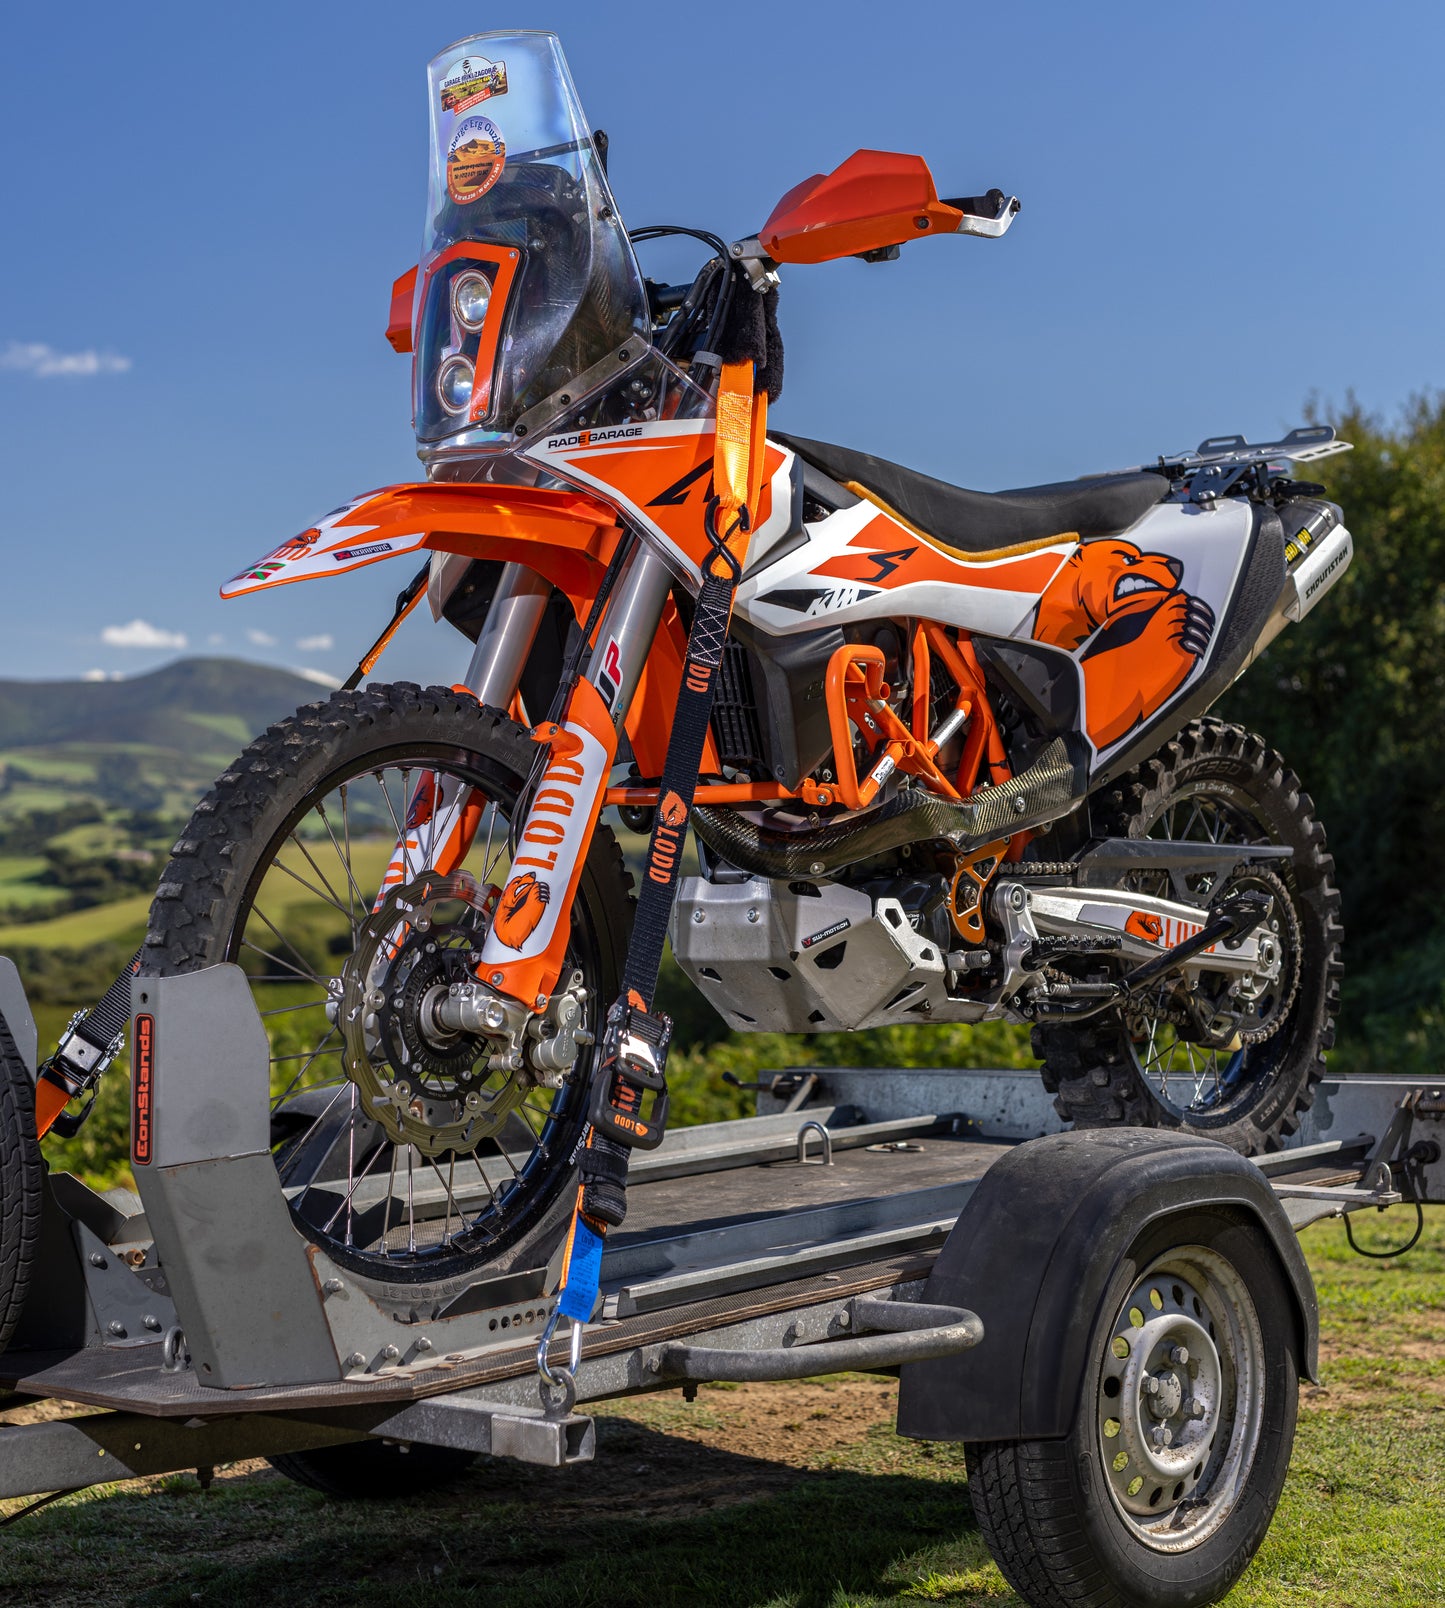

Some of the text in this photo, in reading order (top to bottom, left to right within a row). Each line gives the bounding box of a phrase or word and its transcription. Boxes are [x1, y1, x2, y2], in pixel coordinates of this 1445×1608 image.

[444, 77, 461, 88] GARAGE
[469, 119, 483, 130] Erg
[484, 122, 502, 156] Ouzina
[589, 427, 643, 443] GARAGE
[514, 758, 585, 871] LODD
[649, 825, 680, 884] LODD
[811, 921, 849, 943] SW-MOTECH
[614, 1114, 635, 1129] LODD
